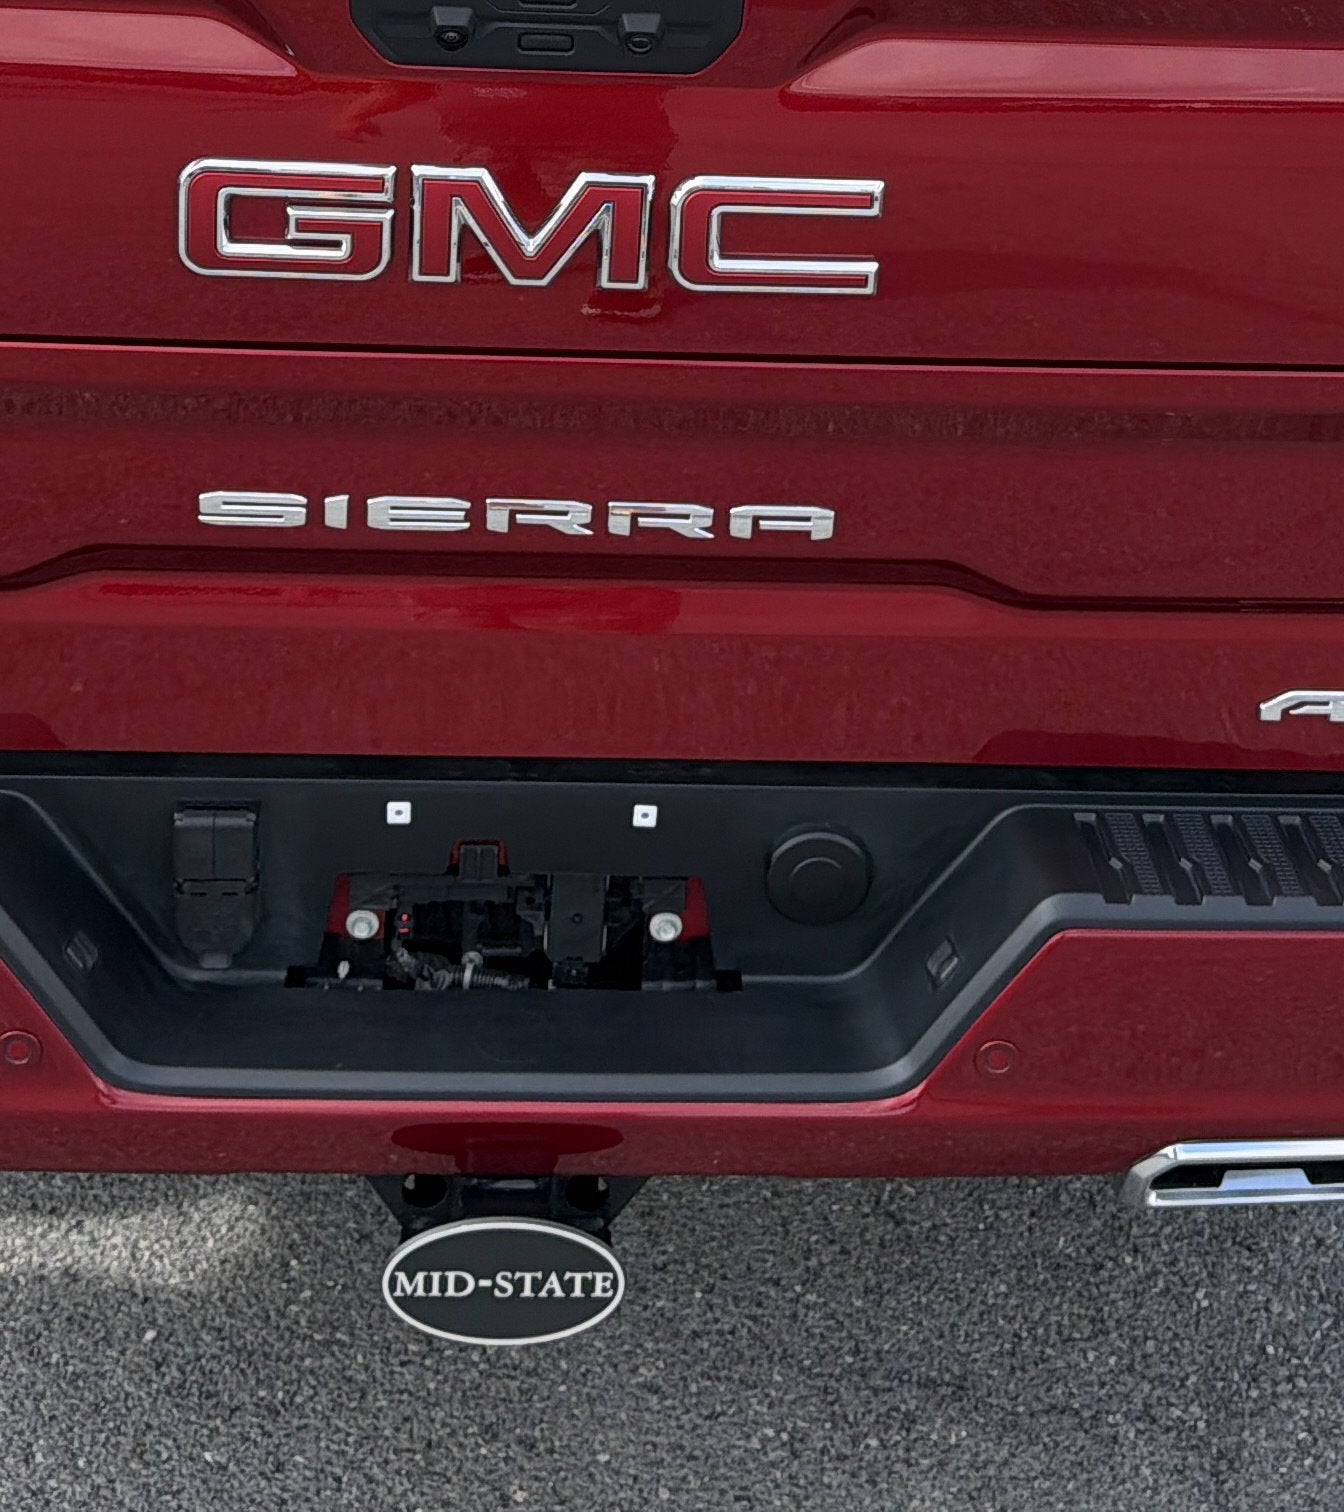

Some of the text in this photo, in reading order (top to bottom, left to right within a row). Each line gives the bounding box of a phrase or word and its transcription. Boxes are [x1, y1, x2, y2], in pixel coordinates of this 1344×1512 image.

[178, 157, 885, 296] GMC
[197, 490, 835, 541] SIERRA
[392, 1270, 614, 1298] MID-STATE
